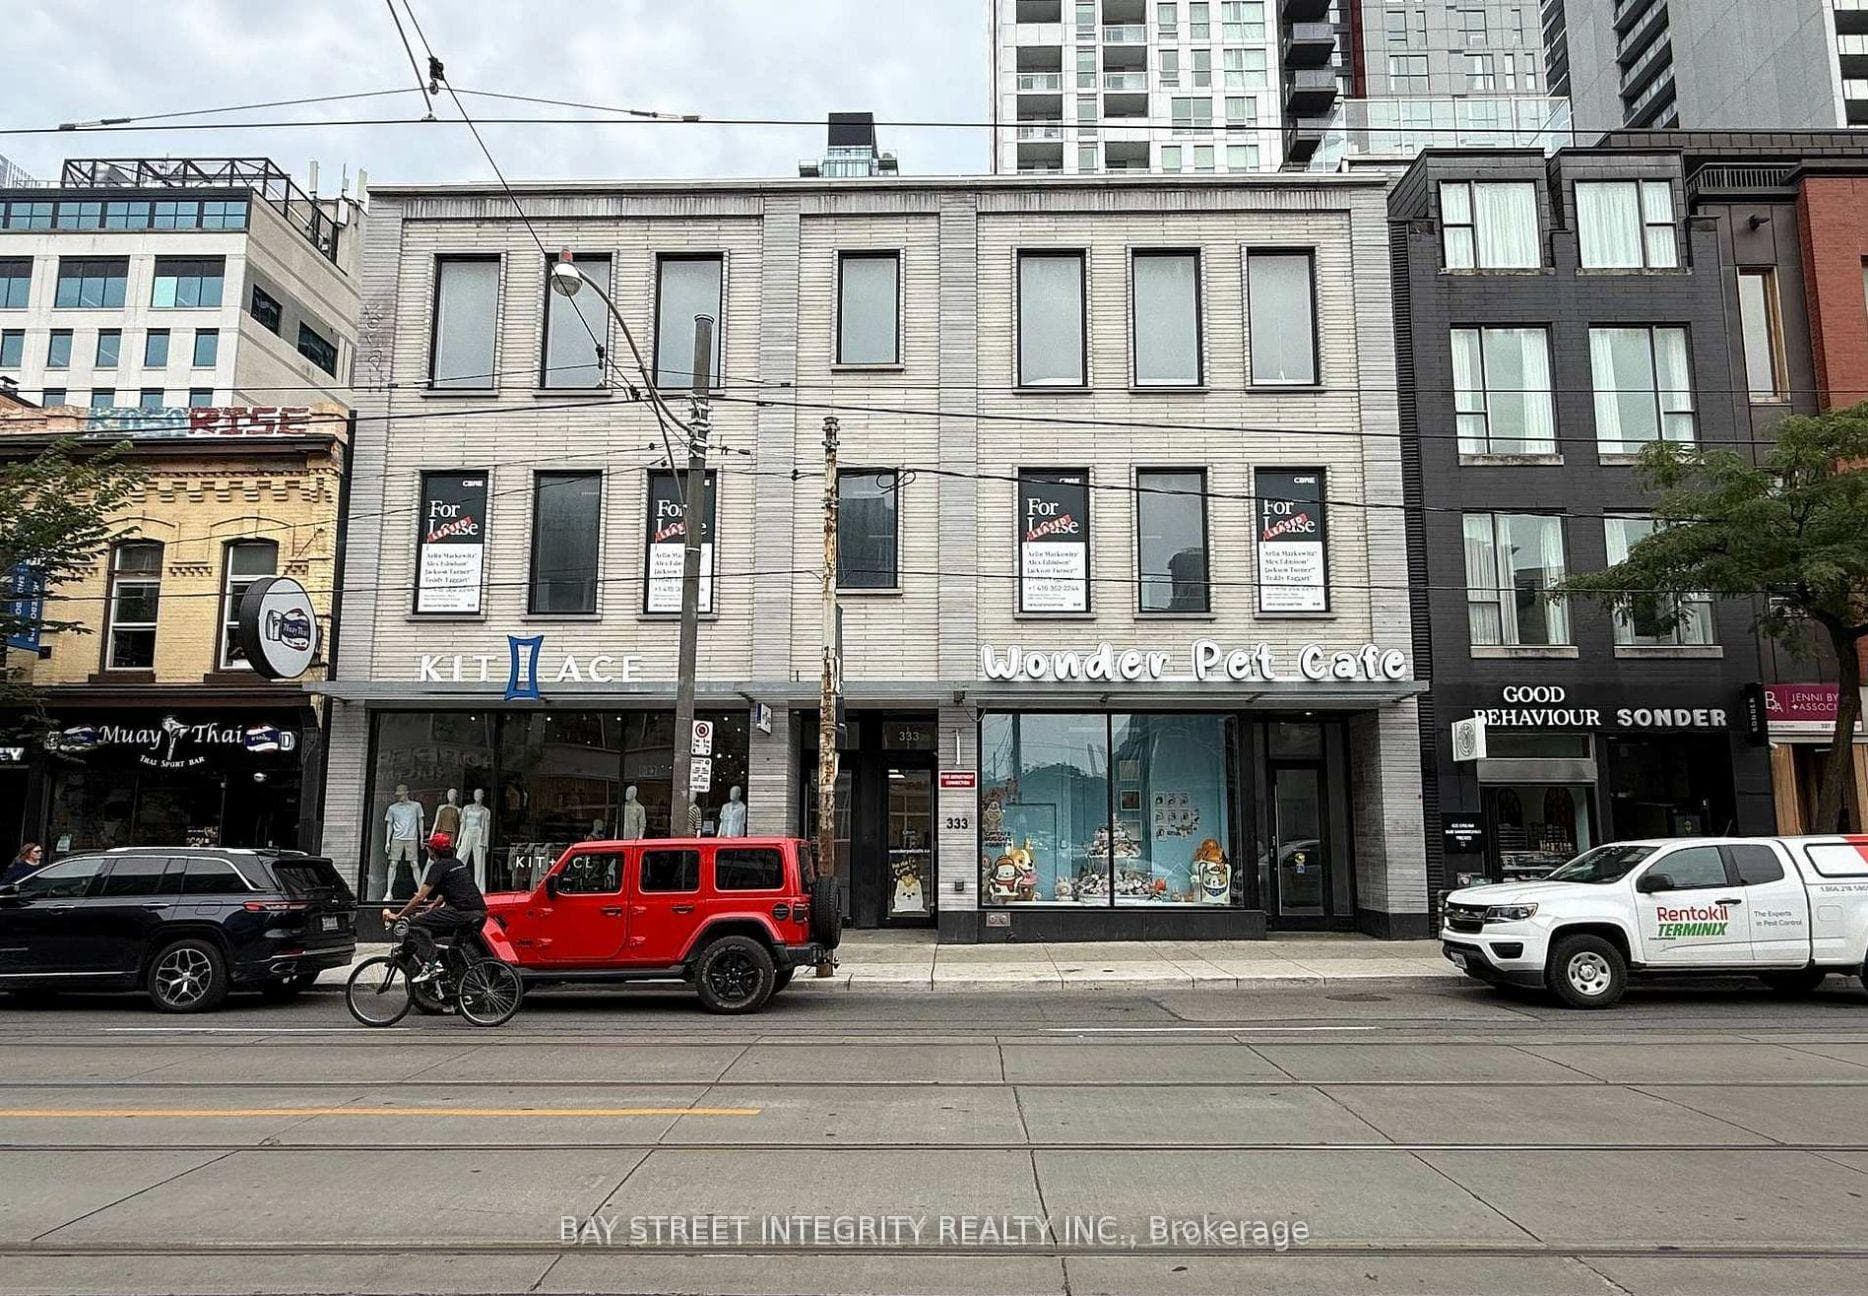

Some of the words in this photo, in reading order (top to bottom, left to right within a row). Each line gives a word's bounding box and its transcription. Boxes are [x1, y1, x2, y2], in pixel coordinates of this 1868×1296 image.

[429, 500, 460, 518] For
[657, 500, 687, 517] For
[1027, 498, 1059, 516] For
[1263, 499, 1294, 515] For
[980, 641, 1171, 680] Wonder
[1192, 638, 1276, 680] Pet
[1299, 643, 1407, 680] Cafe
[419, 654, 497, 682] KIT
[556, 654, 643, 683] ACE
[1503, 686, 1565, 703] GOOD
[1791, 693, 1824, 702] JENNI
[1827, 693, 1838, 702] BY
[1791, 703, 1838, 711] +ASSOCI
[1473, 708, 1601, 727] BEHAVIOUR
[1617, 708, 1727, 727] SONDER
[99, 725, 162, 750] Muay
[191, 724, 243, 744] Thai
[899, 731, 920, 741] 333
[946, 817, 968, 829] 333
[1656, 906, 1728, 921] Rentokil
[1767, 910, 1792, 918] Experts
[1658, 922, 1729, 937] TERMINIX
